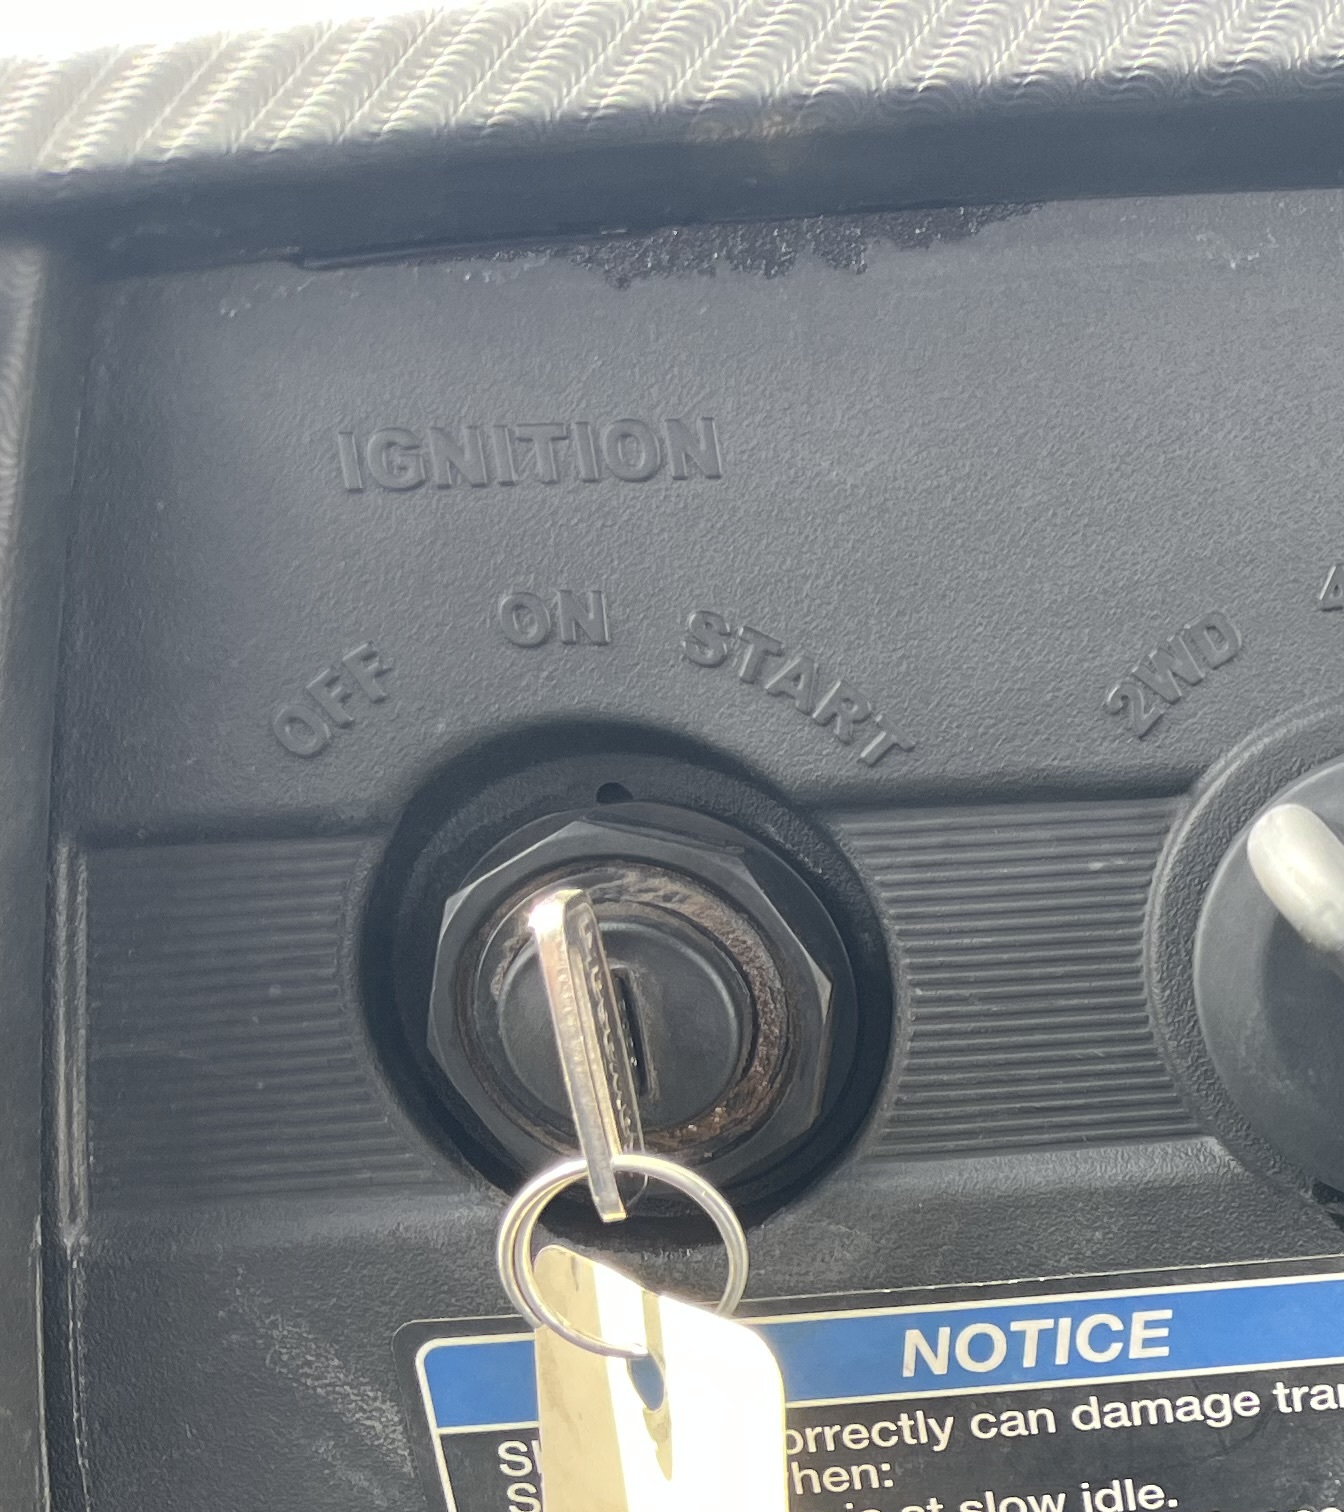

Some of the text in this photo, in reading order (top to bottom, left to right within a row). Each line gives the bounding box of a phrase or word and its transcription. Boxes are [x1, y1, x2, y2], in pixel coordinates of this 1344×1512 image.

[338, 416, 723, 494] IGNITION
[500, 589, 611, 648] ON
[271, 641, 393, 758] OFF
[680, 609, 916, 768] START
[1105, 610, 1242, 740] 2WD
[901, 1308, 1173, 1378] NOTICE
[787, 1410, 955, 1457] orrectly
[969, 1406, 1058, 1441] can
[1070, 1388, 1261, 1432] damage
[788, 1461, 895, 1495] hen:
